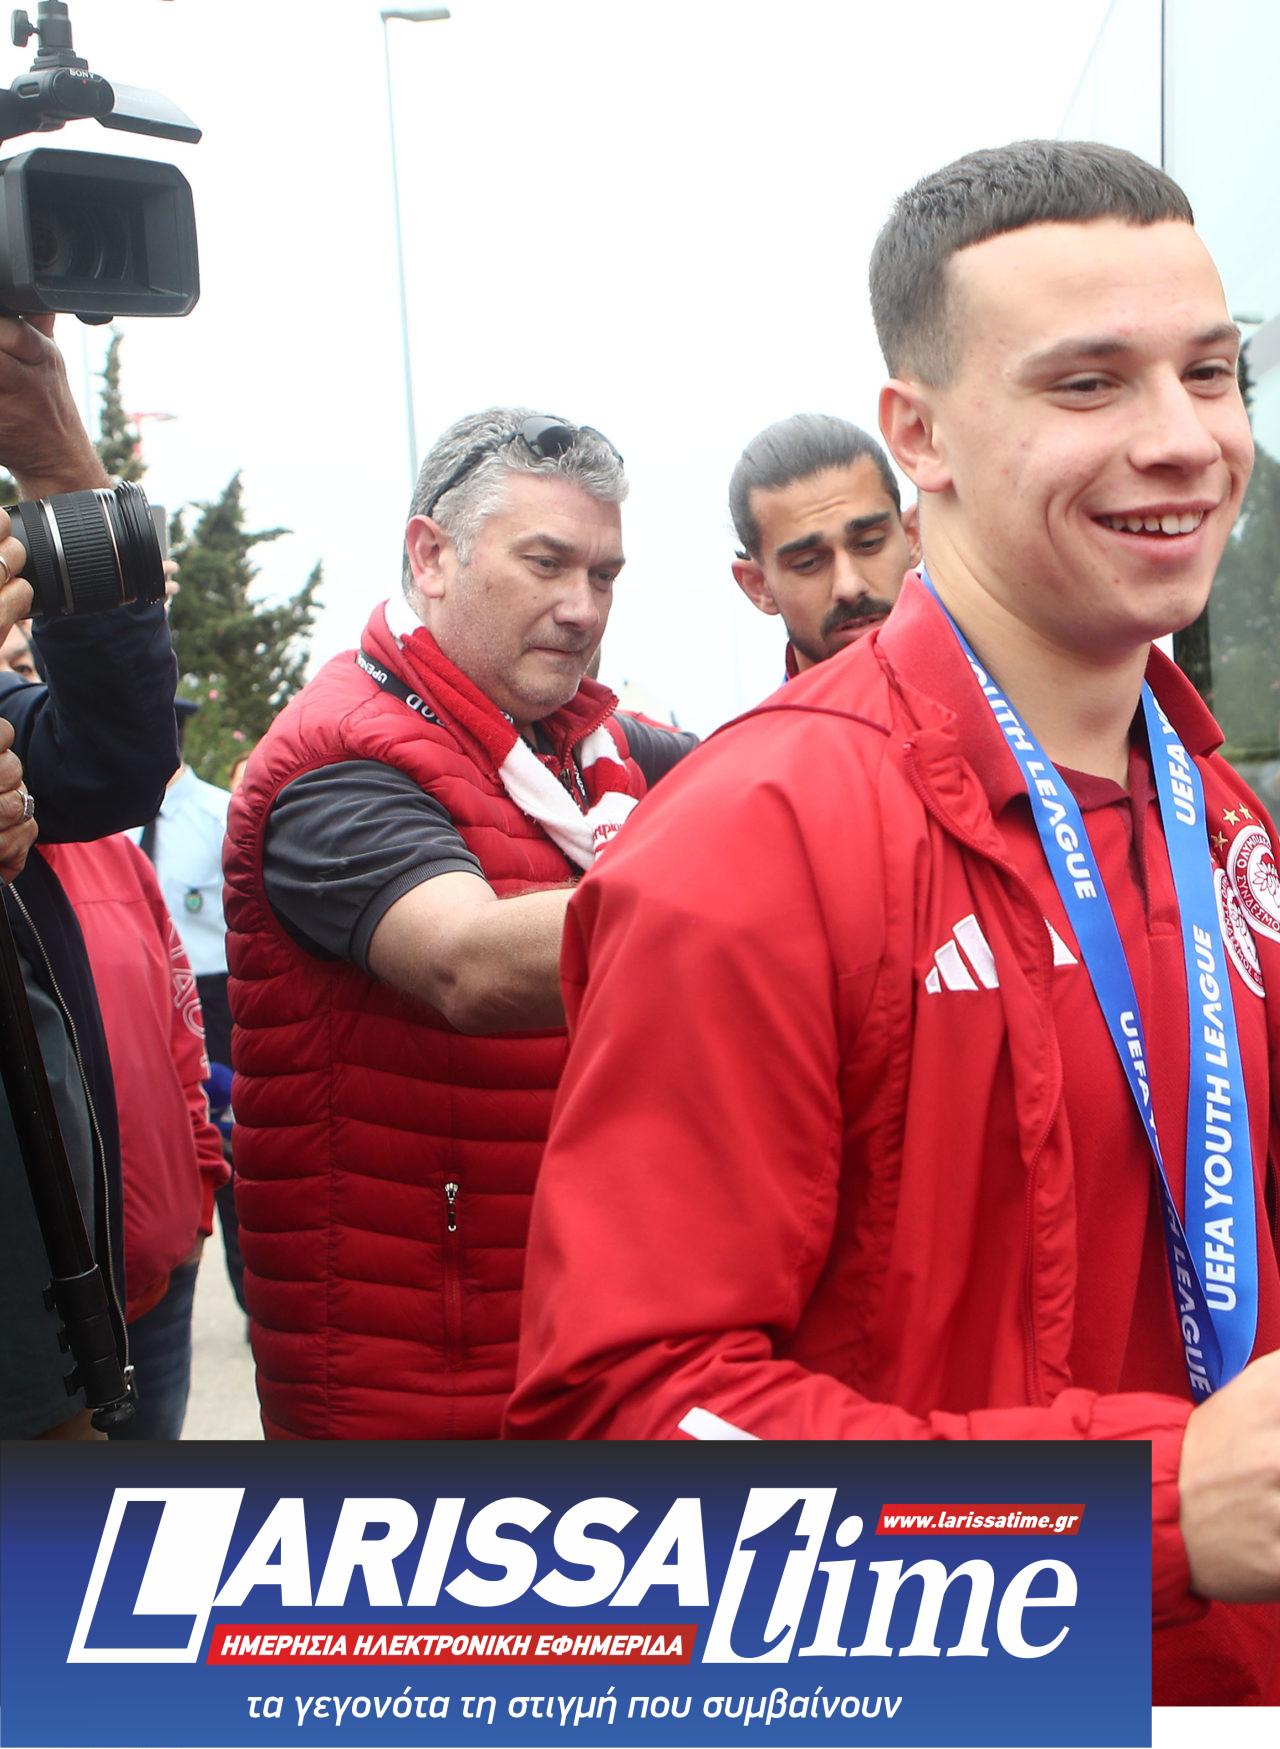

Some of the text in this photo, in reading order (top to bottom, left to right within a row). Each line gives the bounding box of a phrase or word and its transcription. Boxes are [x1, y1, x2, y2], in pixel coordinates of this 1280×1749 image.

[70, 69, 94, 79] SONY
[1026, 760, 1097, 900] LEAGUE
[1166, 744, 1197, 827] UEFA
[1120, 1010, 1150, 1107] UEFA
[1193, 924, 1238, 1313] UEFA YOUTH LEAGUE
